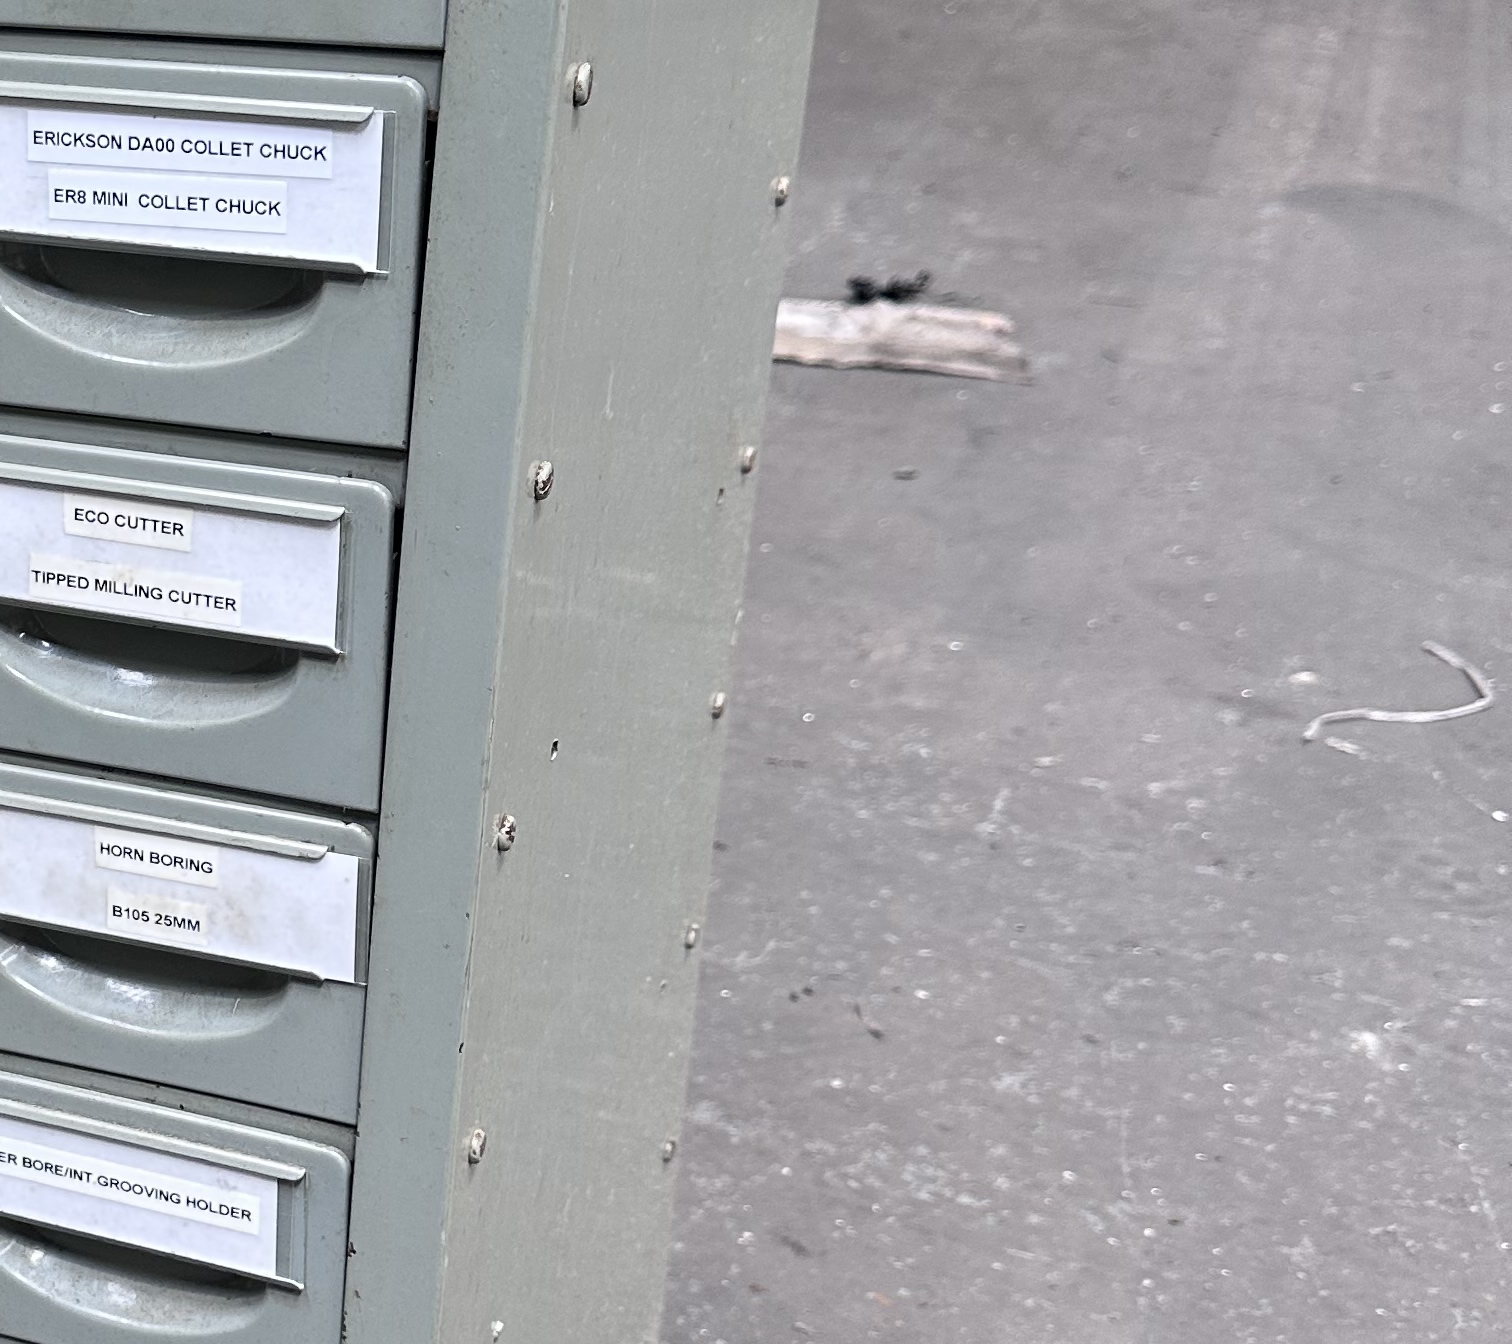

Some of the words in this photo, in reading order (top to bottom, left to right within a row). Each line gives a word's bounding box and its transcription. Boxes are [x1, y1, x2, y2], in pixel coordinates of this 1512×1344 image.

[33, 129, 122, 150] ERICKSON
[128, 135, 175, 153] DA00
[180, 139, 254, 158] COLLET
[259, 143, 327, 162] CHUCK
[53, 188, 87, 205] ER8
[92, 190, 128, 207] MINI
[138, 193, 210, 212] COLLET
[215, 198, 281, 217] CHUCK
[74, 507, 110, 525] ECO
[114, 514, 185, 537] CUTTER
[31, 569, 90, 590] TIPPED
[94, 578, 163, 601] MILLING
[168, 589, 237, 612] CUTTER
[100, 842, 144, 862] HORN
[149, 851, 213, 874] BORING
[112, 904, 150, 923] B105
[154, 913, 201, 933] 25MM
[186, 1196, 252, 1222] HOLDER
